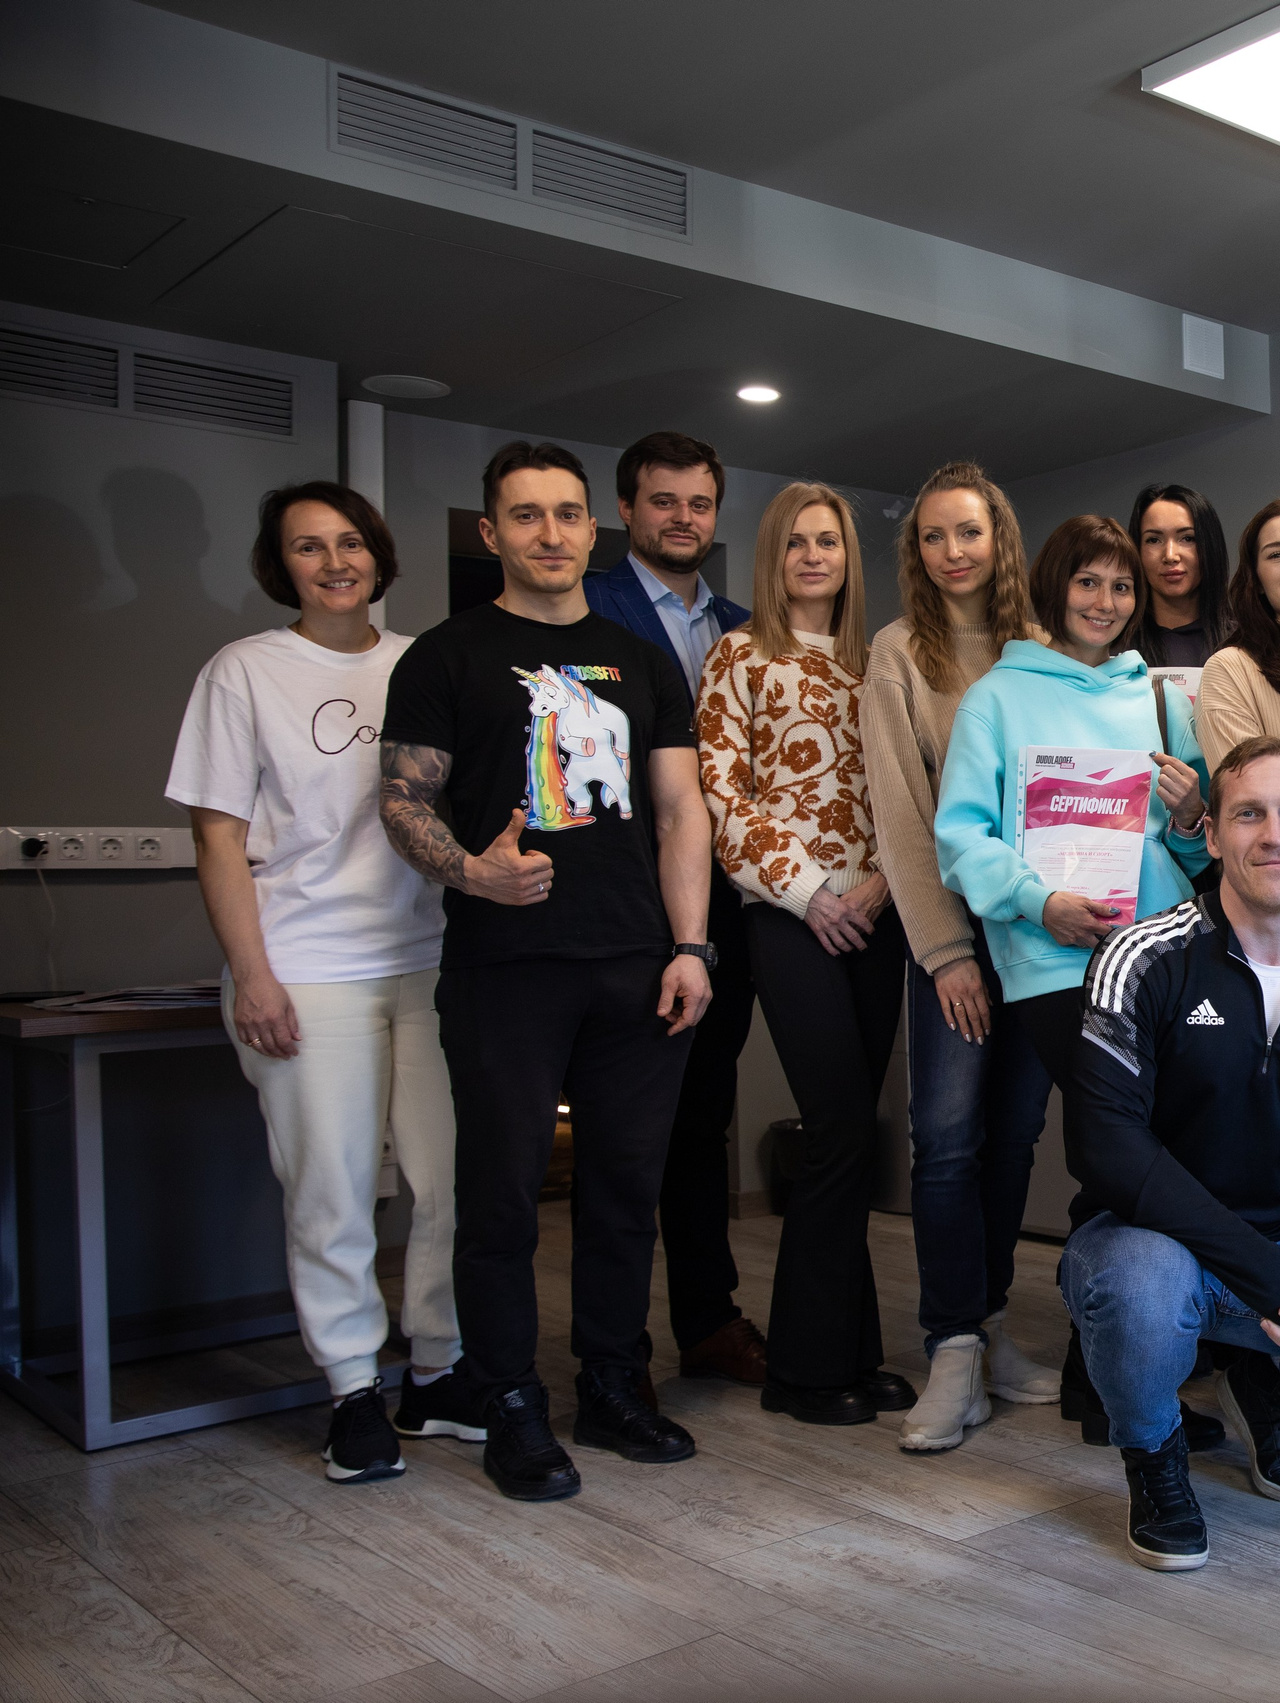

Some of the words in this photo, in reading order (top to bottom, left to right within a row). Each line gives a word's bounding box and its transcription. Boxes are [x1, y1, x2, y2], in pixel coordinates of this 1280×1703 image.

[560, 665, 621, 681] CROSSFIT
[312, 699, 382, 755] Co
[1049, 795, 1129, 815] СЕРТИФИКАТ
[1186, 1014, 1225, 1025] adidas
